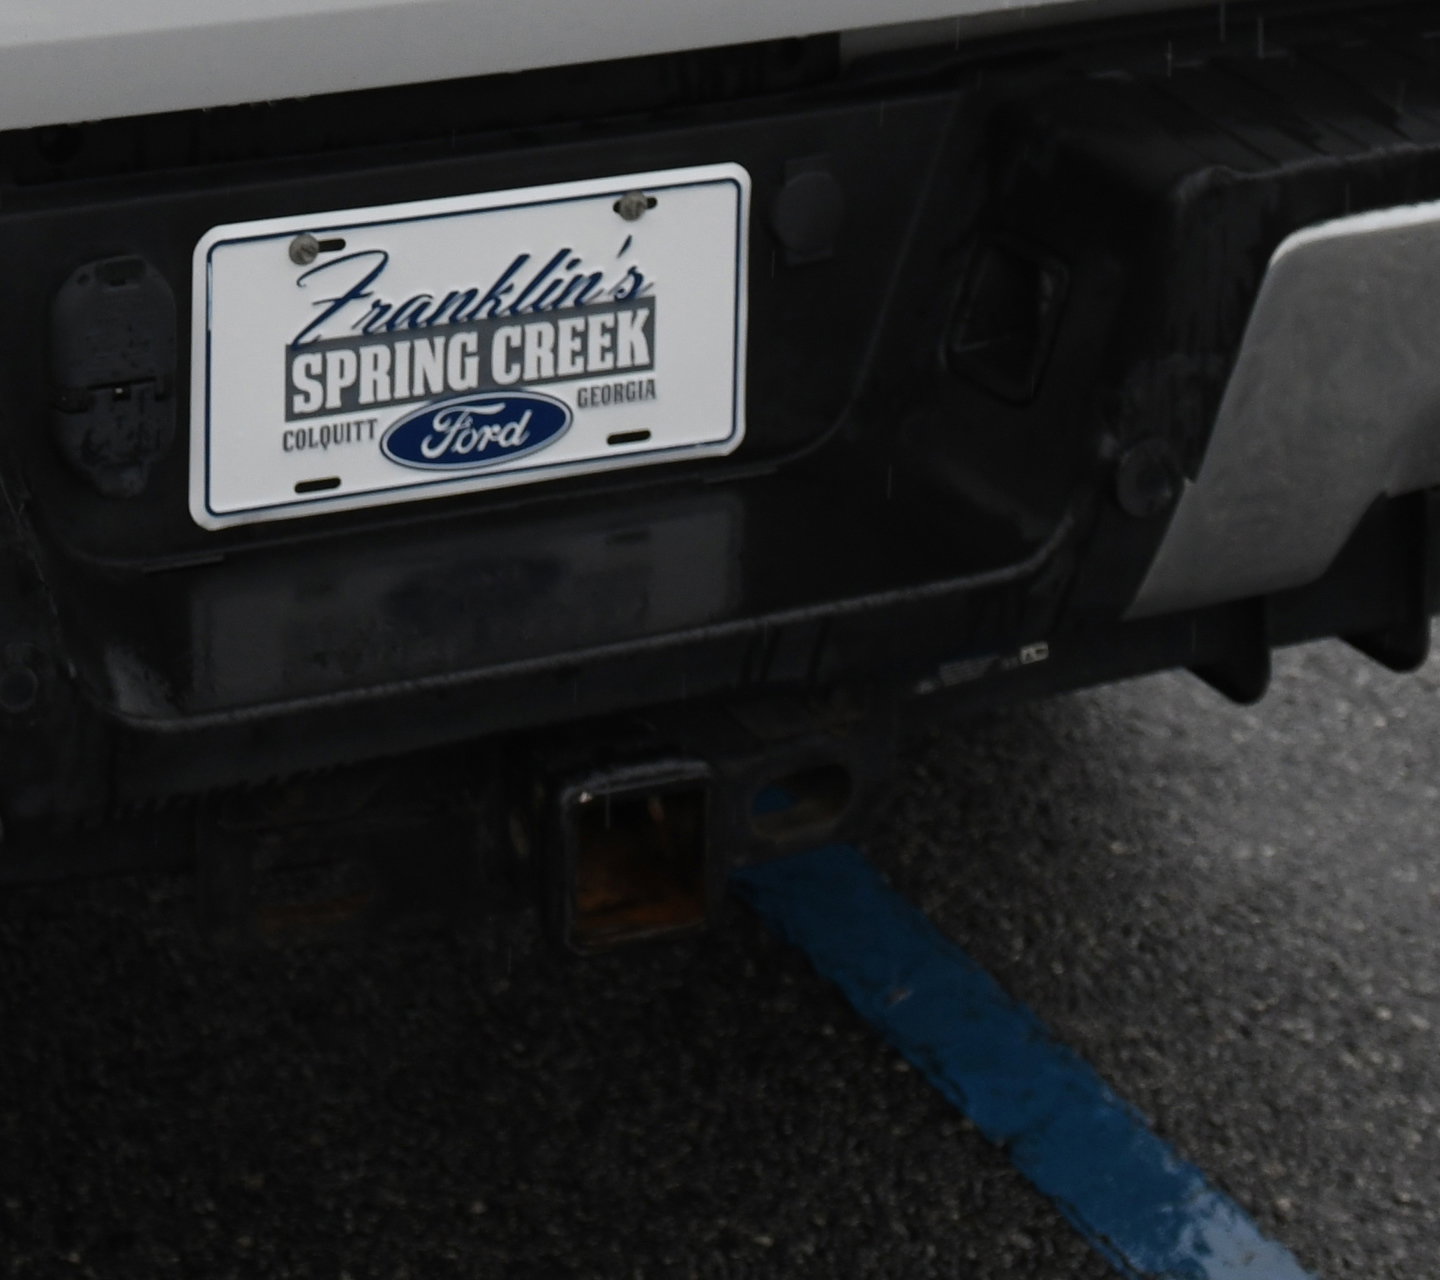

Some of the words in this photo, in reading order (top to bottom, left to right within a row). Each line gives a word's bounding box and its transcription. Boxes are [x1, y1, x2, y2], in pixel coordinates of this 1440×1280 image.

[292, 235, 657, 351] Franklin's
[292, 331, 480, 415] SPRING
[491, 308, 652, 386] CREEK
[576, 378, 657, 409] GEORGIA
[282, 418, 379, 453] COLQUITT
[420, 403, 529, 459] Ford
